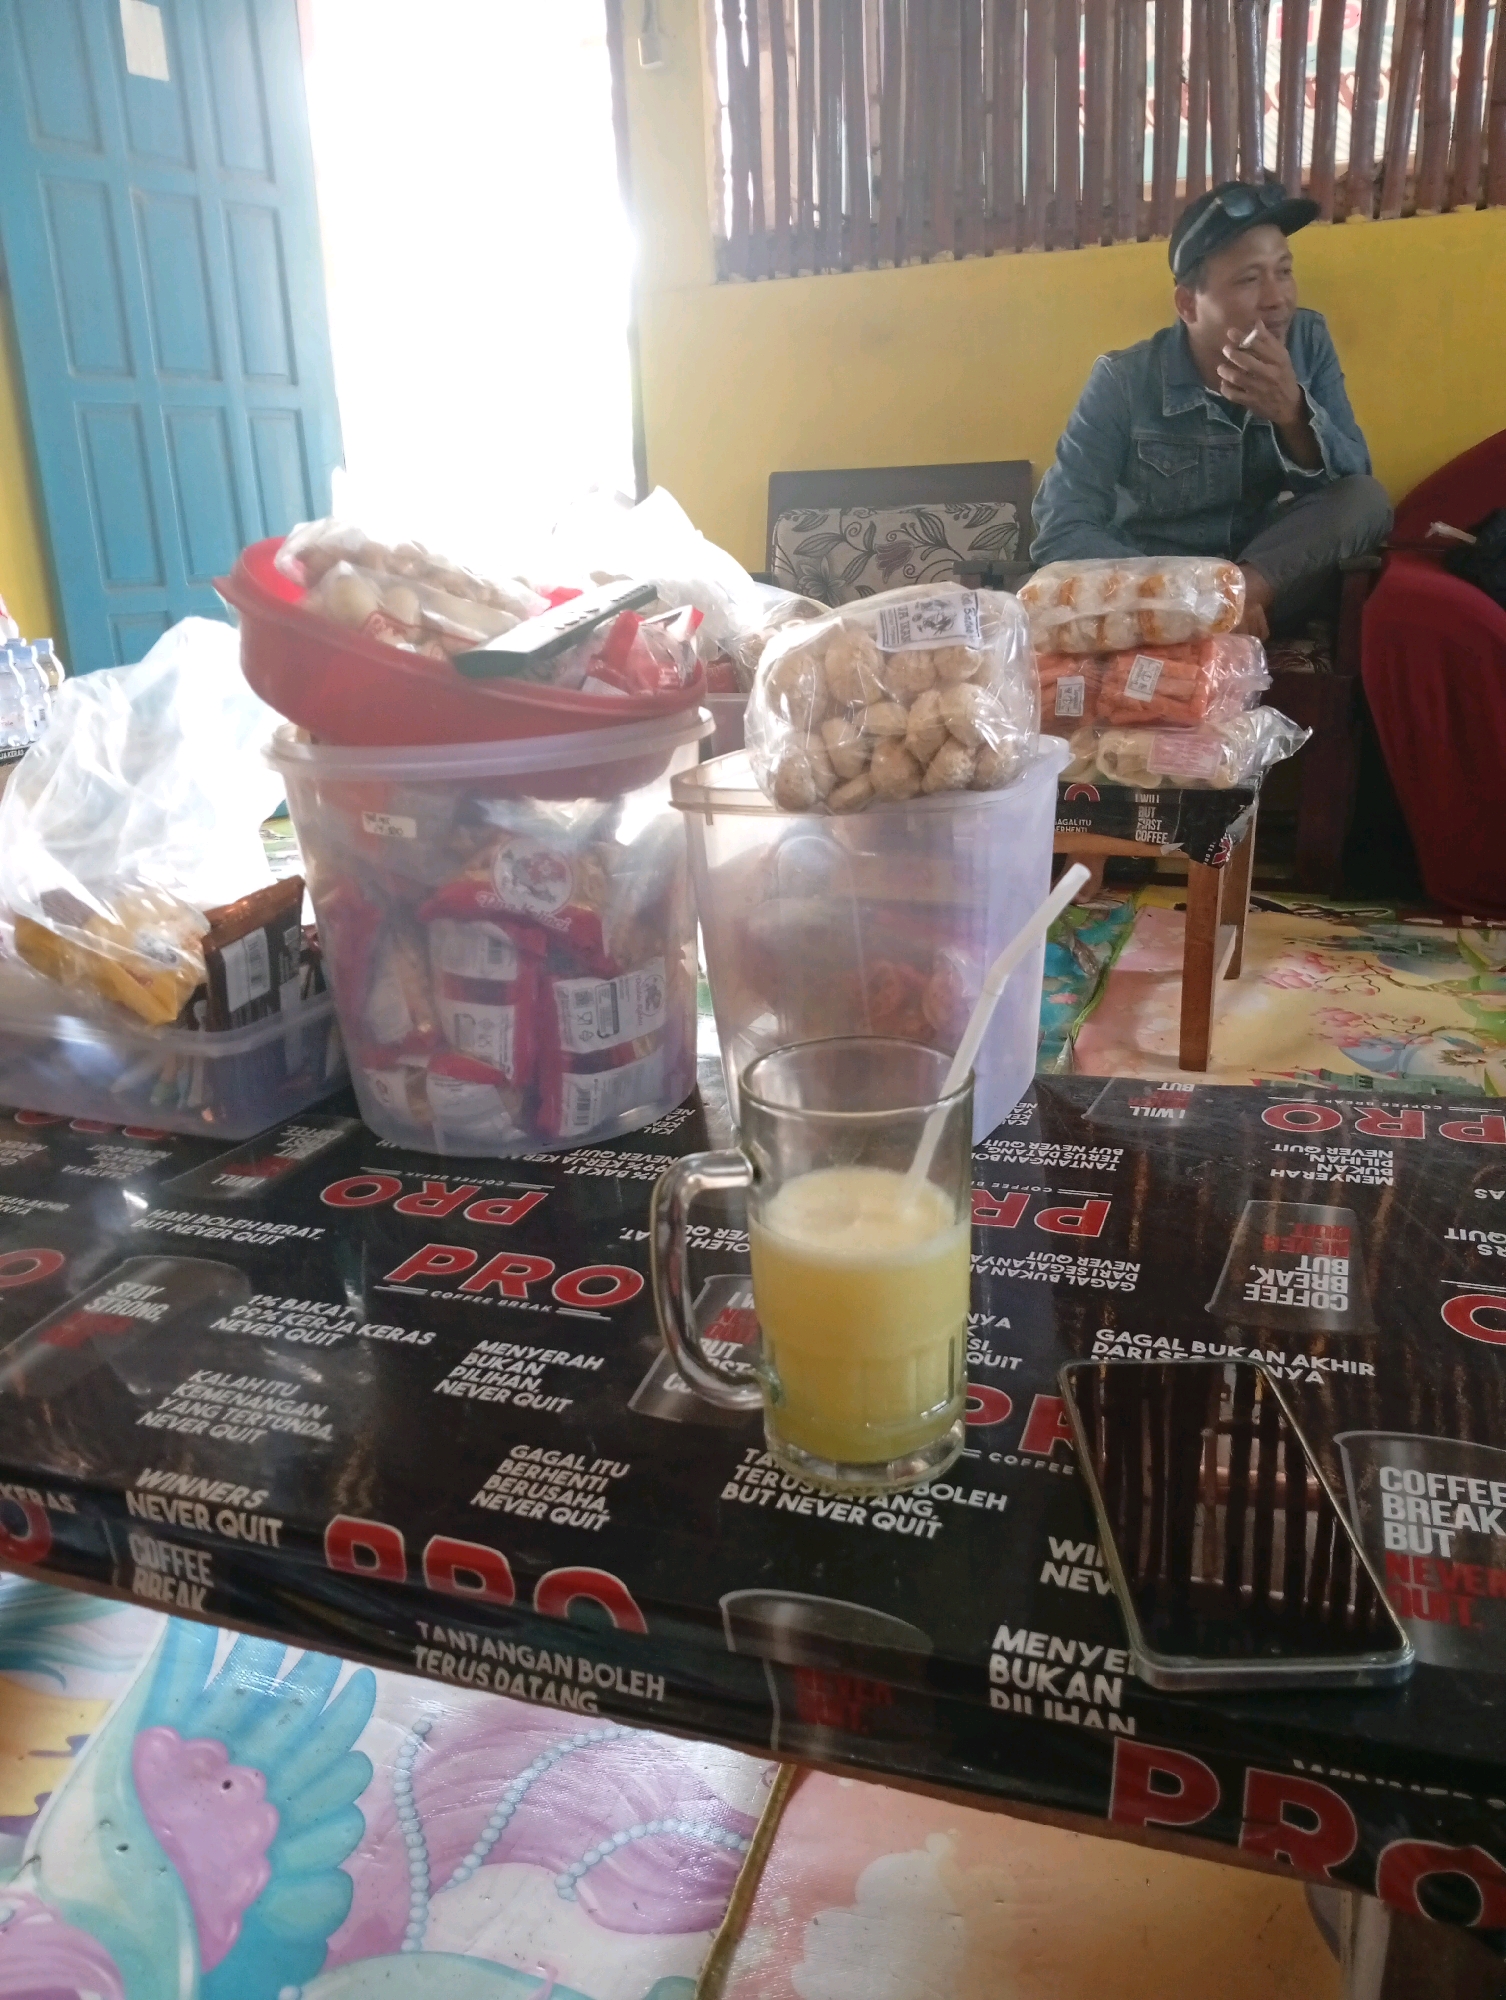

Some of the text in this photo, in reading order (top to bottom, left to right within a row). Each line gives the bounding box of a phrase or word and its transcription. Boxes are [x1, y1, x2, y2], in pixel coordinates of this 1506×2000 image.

[1156, 1082, 1196, 1093] BUT
[1129, 1105, 1174, 1119] WILL
[1261, 1103, 1506, 1146] PRO
[558, 1156, 625, 1170] KERJA
[569, 1148, 680, 1165] NEVER QUIT
[980, 1139, 1125, 1157] BUT NEVER QUIT
[983, 1144, 1122, 1164] TERUS DATANG,
[1269, 1142, 1394, 1159] NEVER QUIT
[1304, 1153, 1394, 1169] PILIHAN,
[563, 1167, 631, 1180] BAKAT
[1002, 1154, 1118, 1173] TANTANGAN
[1268, 1168, 1394, 1187] MENYERAH
[1315, 1163, 1394, 1177] BUKAN
[320, 1174, 550, 1225] PRO
[991, 1182, 1053, 1194] COFFEE
[167, 1224, 235, 1241] NEVER
[231, 1231, 286, 1246] QUIT
[192, 1213, 257, 1230] BOLEH
[382, 1242, 645, 1308] PRO
[990, 1266, 1061, 1284] BUKAN
[1025, 1251, 1141, 1273] NEVER QUIT
[1091, 1267, 1139, 1282] DARI
[1294, 1254, 1350, 1276] BUT
[106, 1281, 167, 1301] STAY
[1065, 1274, 1136, 1293] GAGAL
[1248, 1264, 1349, 1295] BREAK,
[247, 1294, 358, 1319] 1% BAKAT
[429, 1290, 554, 1314] COFFEE BREAK
[1242, 1283, 1349, 1313] COFFEE
[210, 1316, 345, 1347] NEVER QUIT
[230, 1304, 438, 1346] 99% KERJA KERAS
[460, 1352, 547, 1377] BUKAN
[473, 1339, 606, 1371] MENYERAH
[966, 1351, 1024, 1371] QUIT
[1090, 1340, 1154, 1360] DARI
[1094, 1327, 1378, 1378] GAGAL BUKAN AKHIR
[187, 1368, 302, 1398] KALAH ITU
[446, 1365, 545, 1394] PILIHAN,
[156, 1396, 225, 1420] YANG
[170, 1382, 331, 1420] KEMENANGAN
[432, 1379, 575, 1415] NEVER QUIT
[135, 1411, 269, 1444] NEVER QUIT
[495, 1457, 611, 1495] BERHENTI
[508, 1443, 632, 1480] GAGAL ITU
[988, 1451, 1075, 1476] COFFEE
[135, 1467, 271, 1510] WINNERS
[482, 1472, 612, 1514] BERUSAHA,
[911, 1480, 1009, 1514] BOLEH
[1379, 1465, 1506, 1508] COFFEE
[125, 1490, 285, 1549] NEVER QUIT
[469, 1489, 612, 1533] NEVER QUIT
[720, 1481, 943, 1540] BUT NEVER QUIT
[1381, 1491, 1506, 1537] BREAK
[1383, 1520, 1457, 1559] BUT
[129, 1532, 216, 1589] COFFEE
[1039, 1559, 1117, 1596] NEV
[415, 1620, 666, 1702] TANTANGAN BOLEH
[990, 1623, 1136, 1676] MENYE
[413, 1644, 599, 1716] TERUS DATANG
[988, 1652, 1123, 1710] BUKAN
